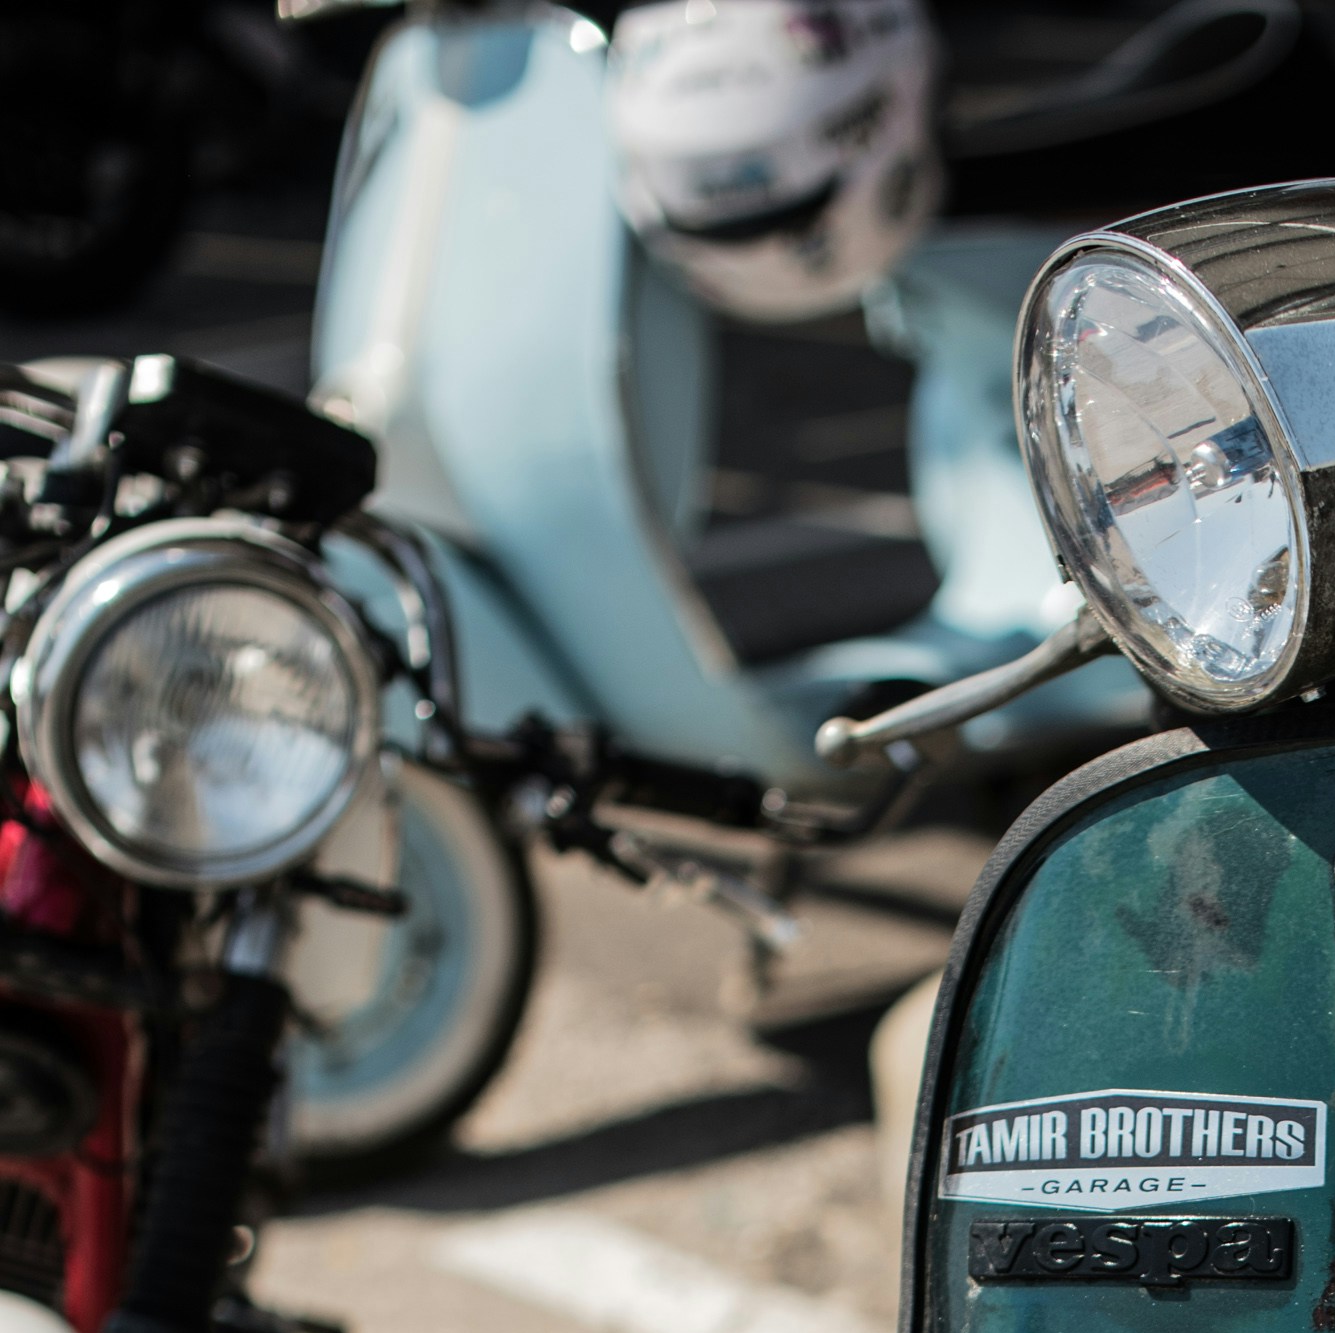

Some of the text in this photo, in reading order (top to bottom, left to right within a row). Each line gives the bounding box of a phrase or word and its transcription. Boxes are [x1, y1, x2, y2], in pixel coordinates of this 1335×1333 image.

[955, 1105, 1307, 1167] TAMIR BROTHERS
[971, 1221, 1285, 1287] vespa
